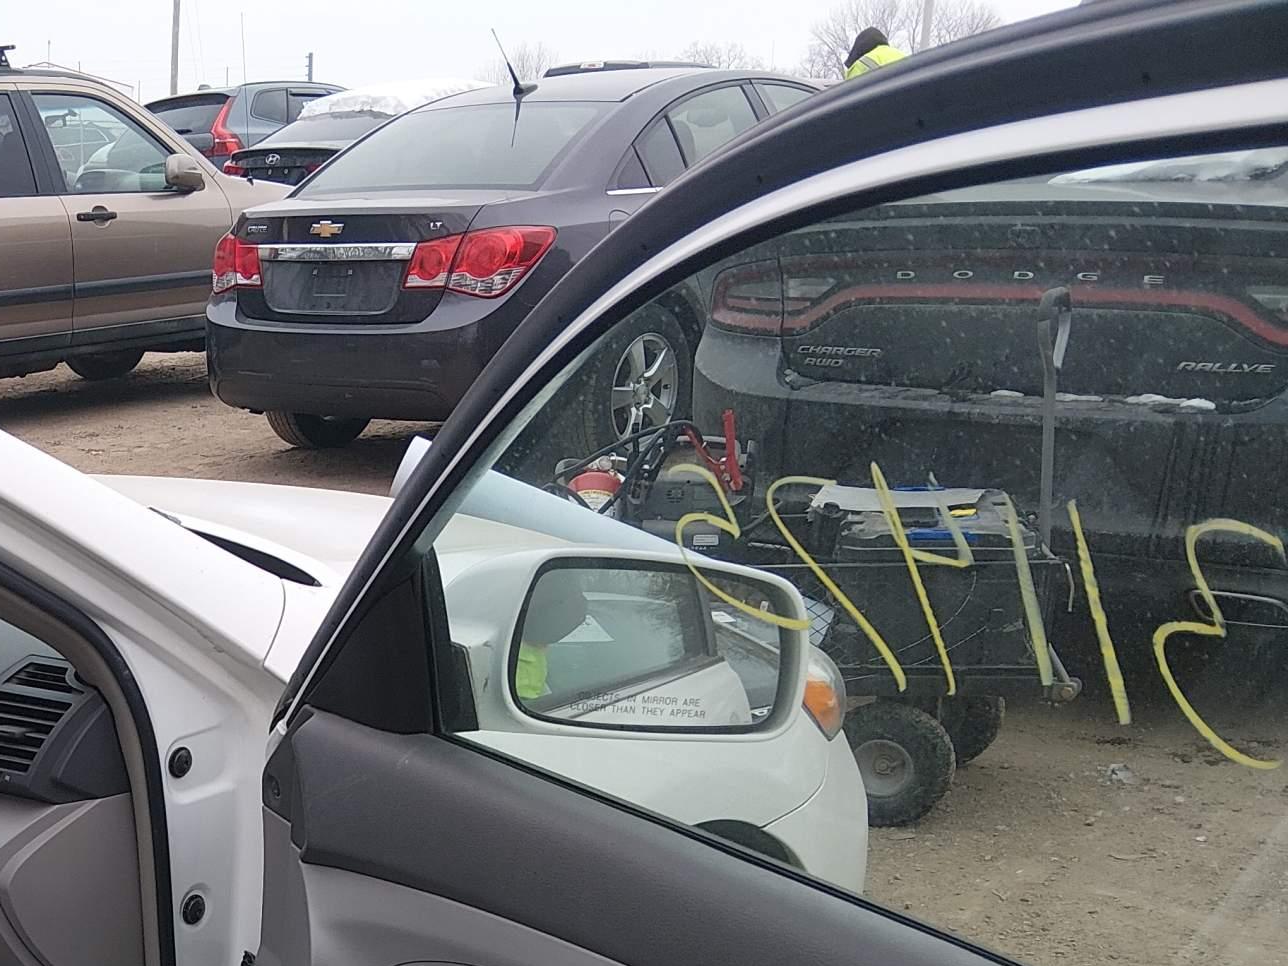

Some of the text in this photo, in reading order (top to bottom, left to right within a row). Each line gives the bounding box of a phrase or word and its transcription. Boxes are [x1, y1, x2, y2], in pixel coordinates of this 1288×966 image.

[429, 221, 443, 230] LT
[895, 269, 1165, 286] DODGE
[796, 344, 884, 359] CHARGER
[803, 357, 845, 368] AWD
[1176, 361, 1277, 374] RALLYE
[641, 695, 679, 707] MIRROR
[682, 698, 702, 708] ARE
[611, 704, 637, 715] THAN
[641, 706, 666, 717] THEY
[668, 708, 707, 719] APPEAR
